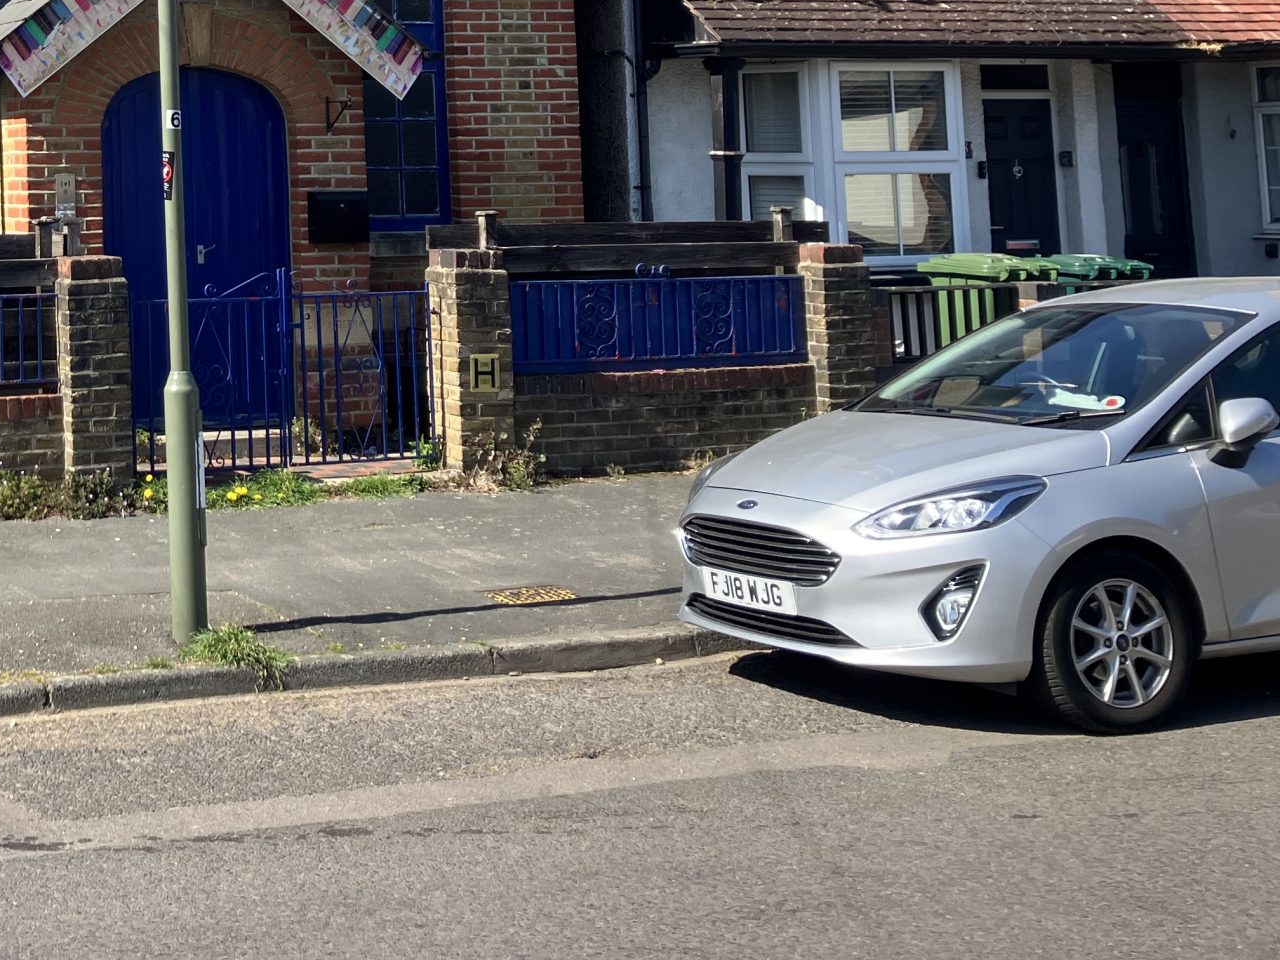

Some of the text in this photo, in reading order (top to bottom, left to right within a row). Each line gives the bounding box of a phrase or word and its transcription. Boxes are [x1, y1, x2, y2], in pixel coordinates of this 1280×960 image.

[171, 111, 181, 128] 6
[474, 358, 496, 389] H
[711, 572, 782, 606] FJ18 WJG
